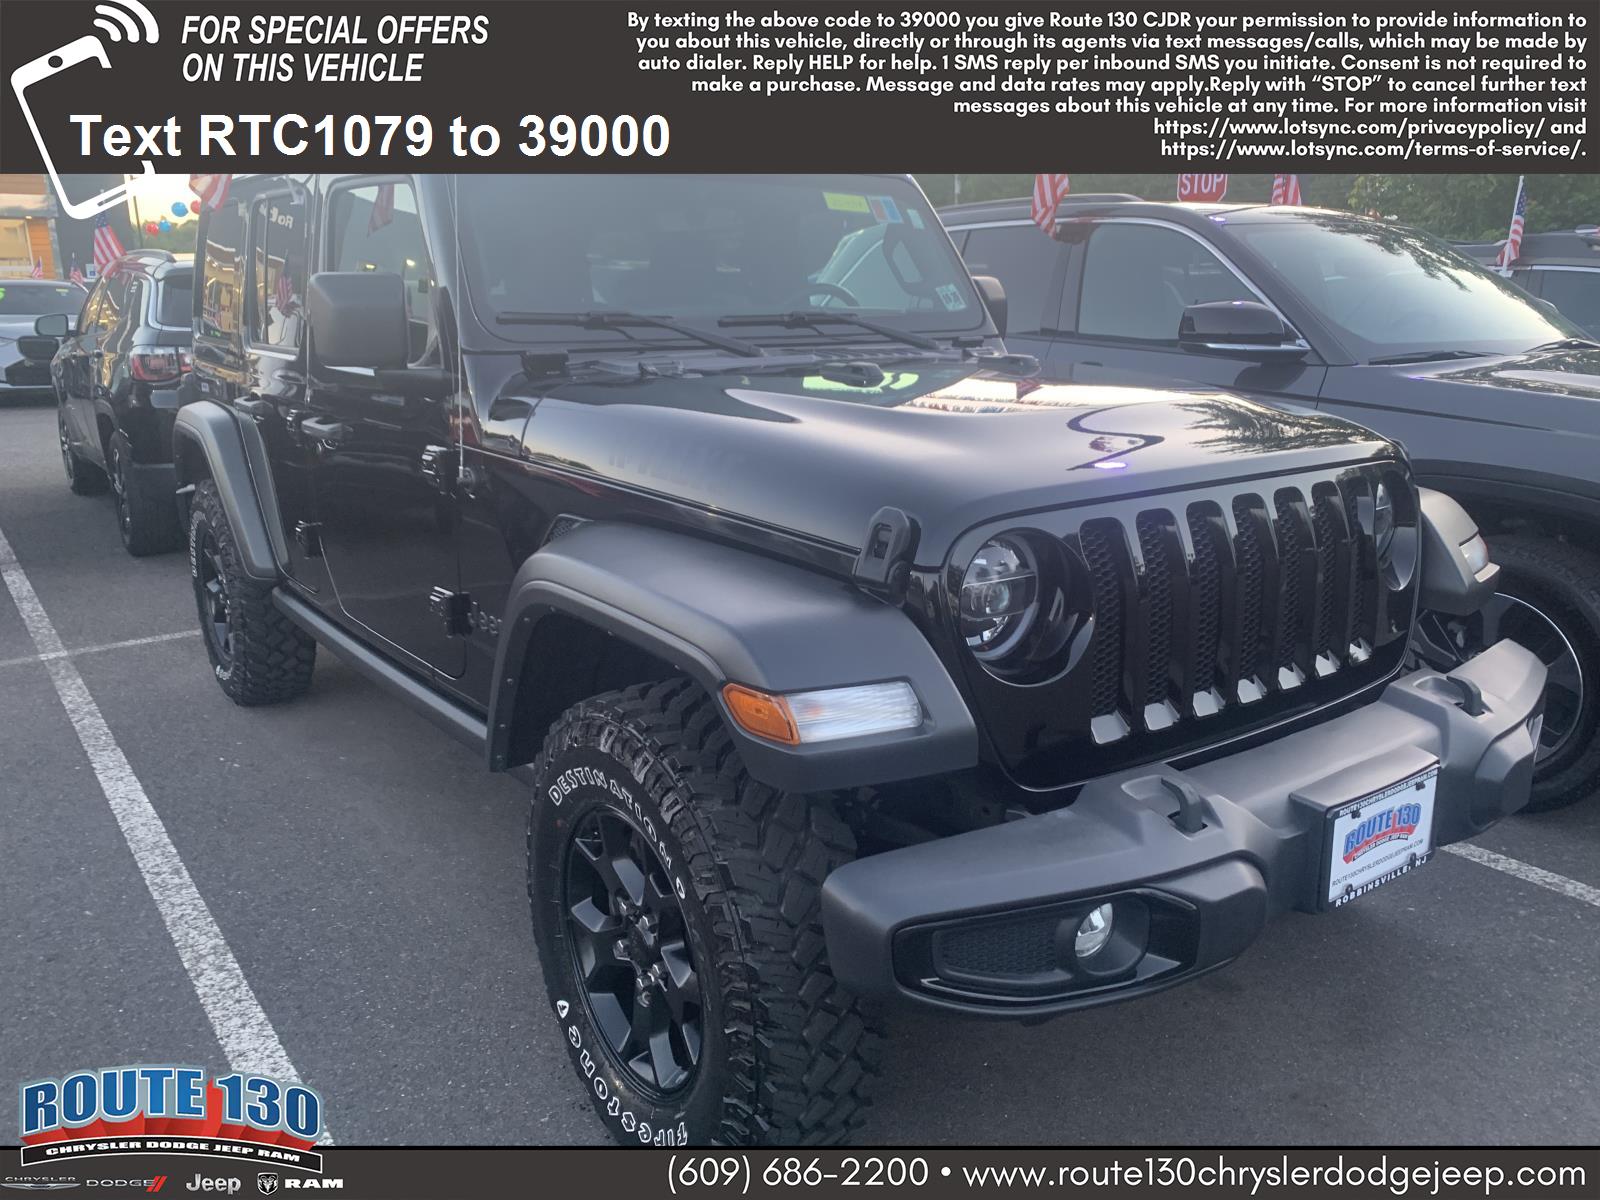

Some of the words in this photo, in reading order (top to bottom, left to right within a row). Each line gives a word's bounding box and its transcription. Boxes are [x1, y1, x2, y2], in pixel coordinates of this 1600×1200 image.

[1181, 174, 1224, 195] STOP
[467, 601, 503, 635] Jee
[548, 766, 672, 870] DESTINATION
[1344, 808, 1394, 853] ROUTE
[1396, 802, 1422, 826] 130
[1335, 865, 1412, 908] ROBBINSVILLE,
[1415, 855, 1427, 867] NJ
